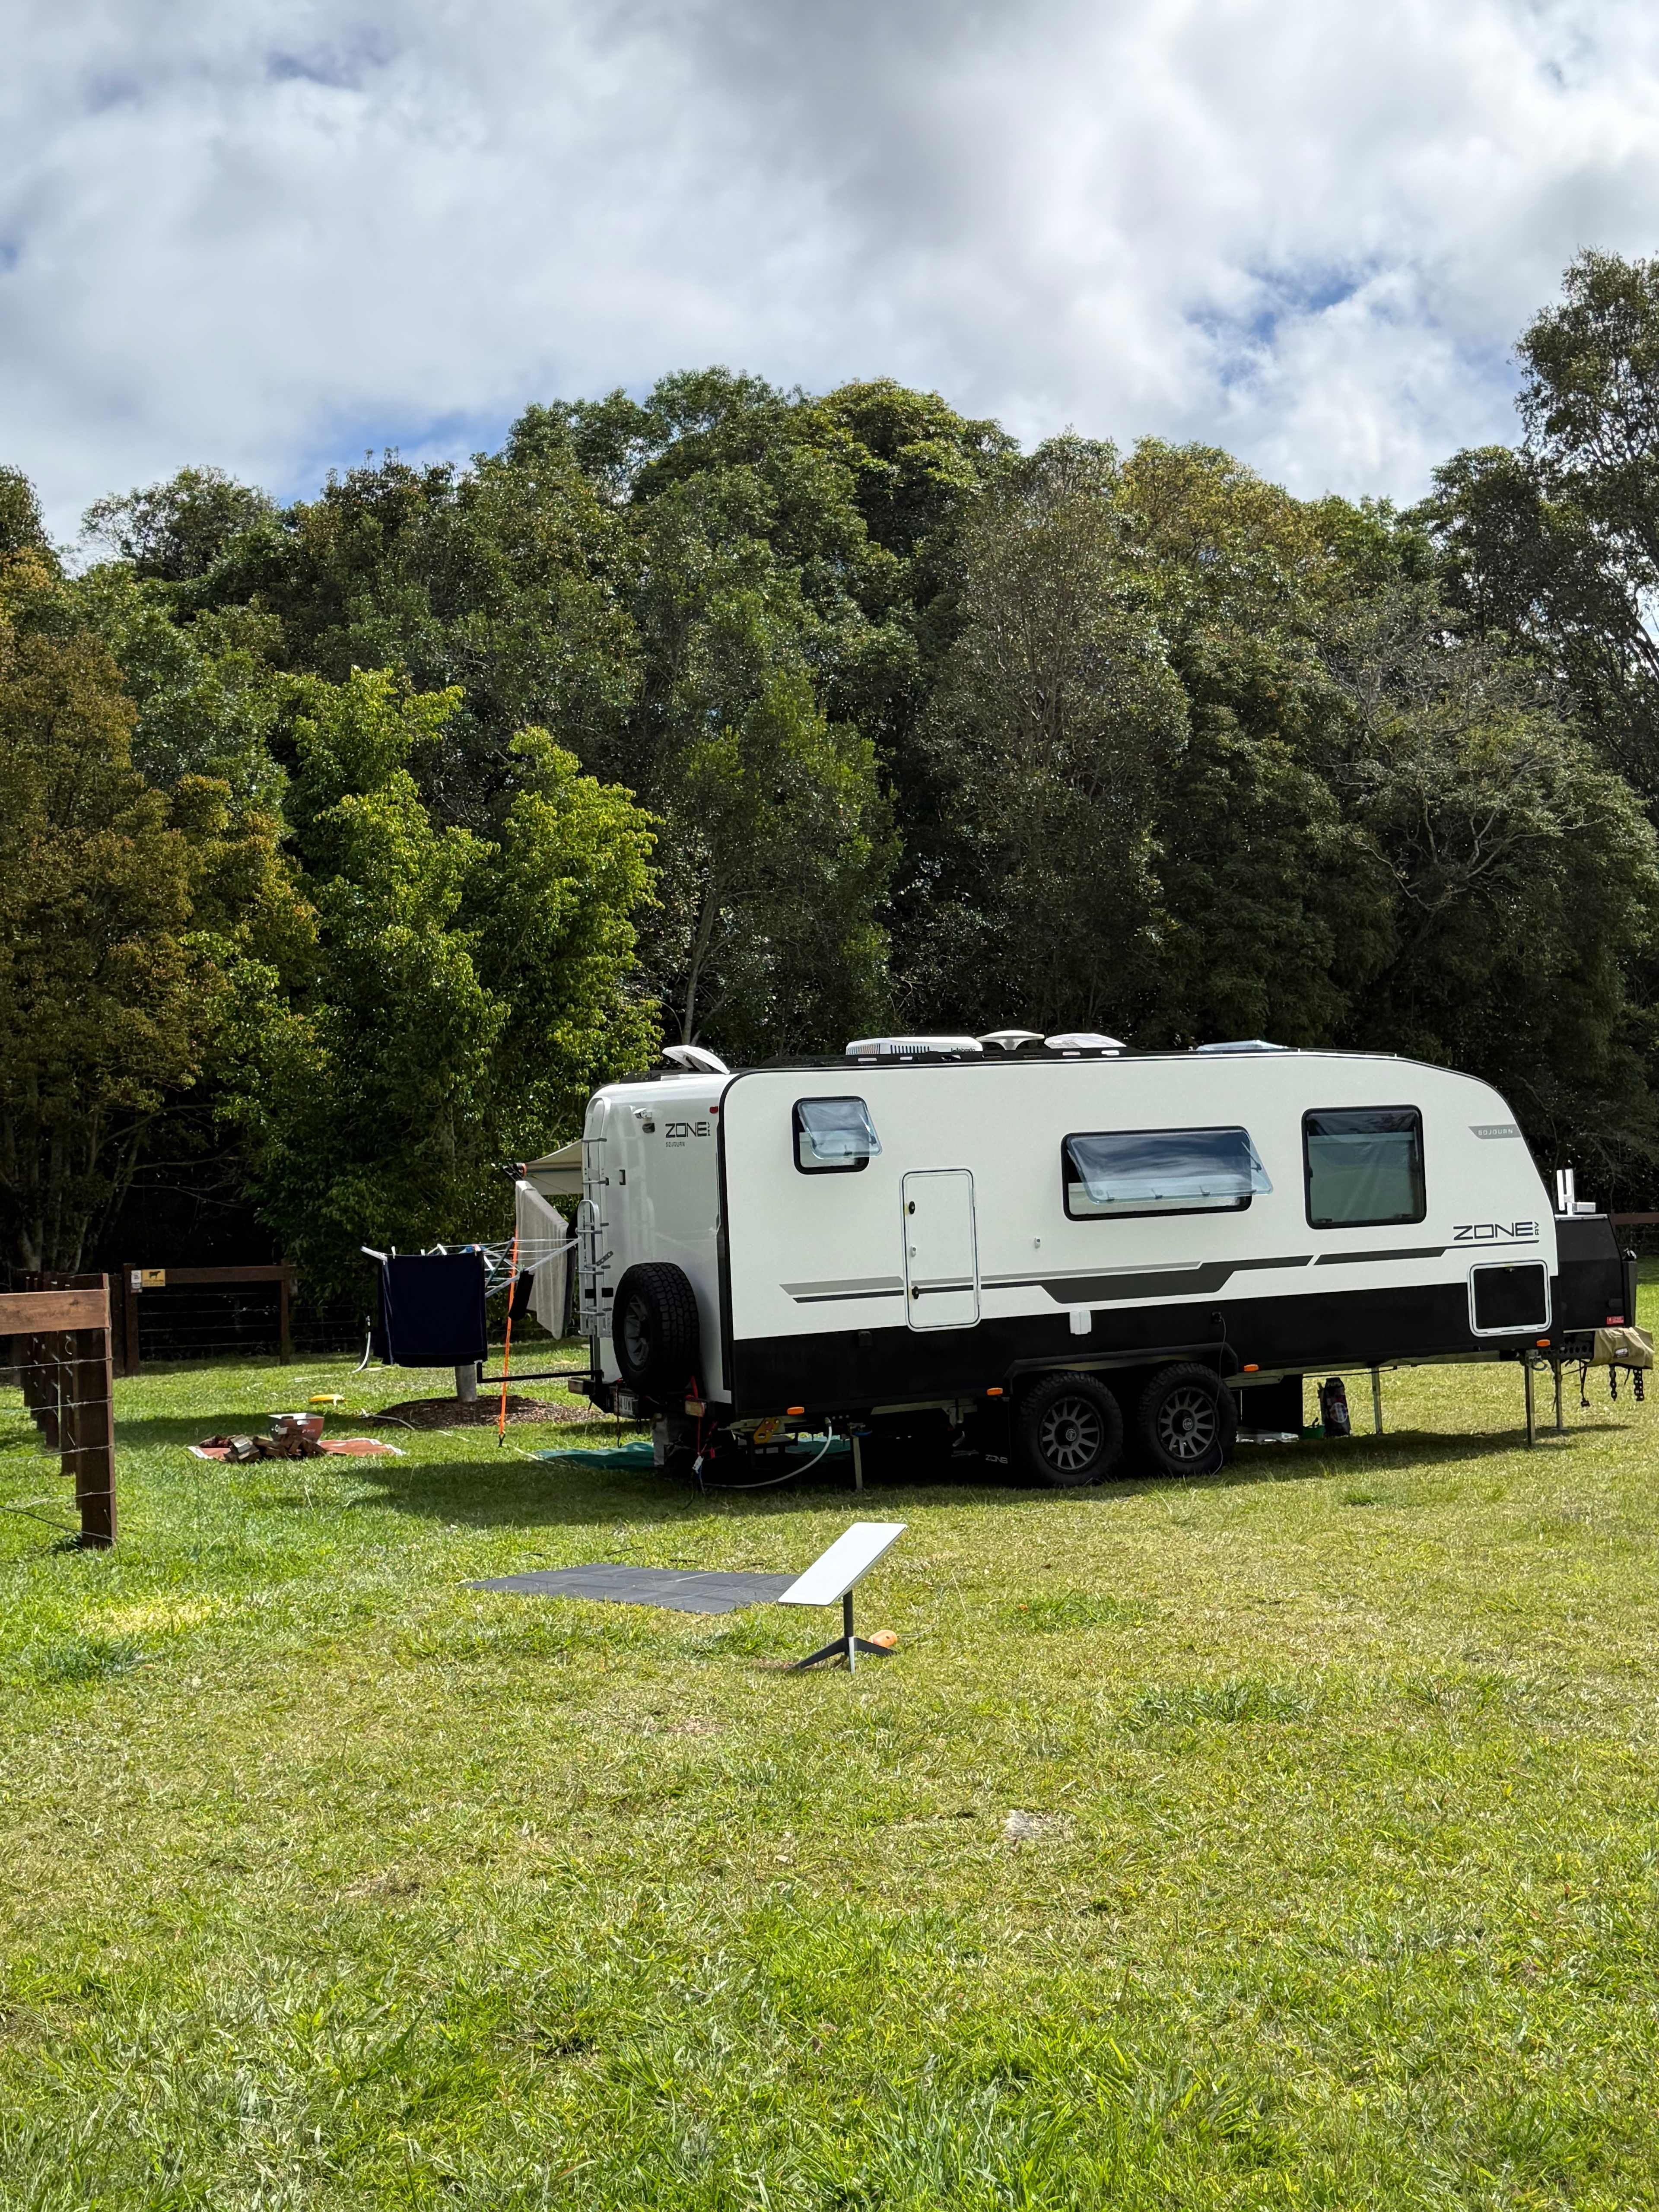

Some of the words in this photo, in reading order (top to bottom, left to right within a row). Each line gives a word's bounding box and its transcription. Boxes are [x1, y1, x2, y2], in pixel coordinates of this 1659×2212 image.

[665, 1122, 707, 1138] ZONE
[1453, 1222, 1533, 1240] ZONE
[1534, 1222, 1539, 1235] RV
